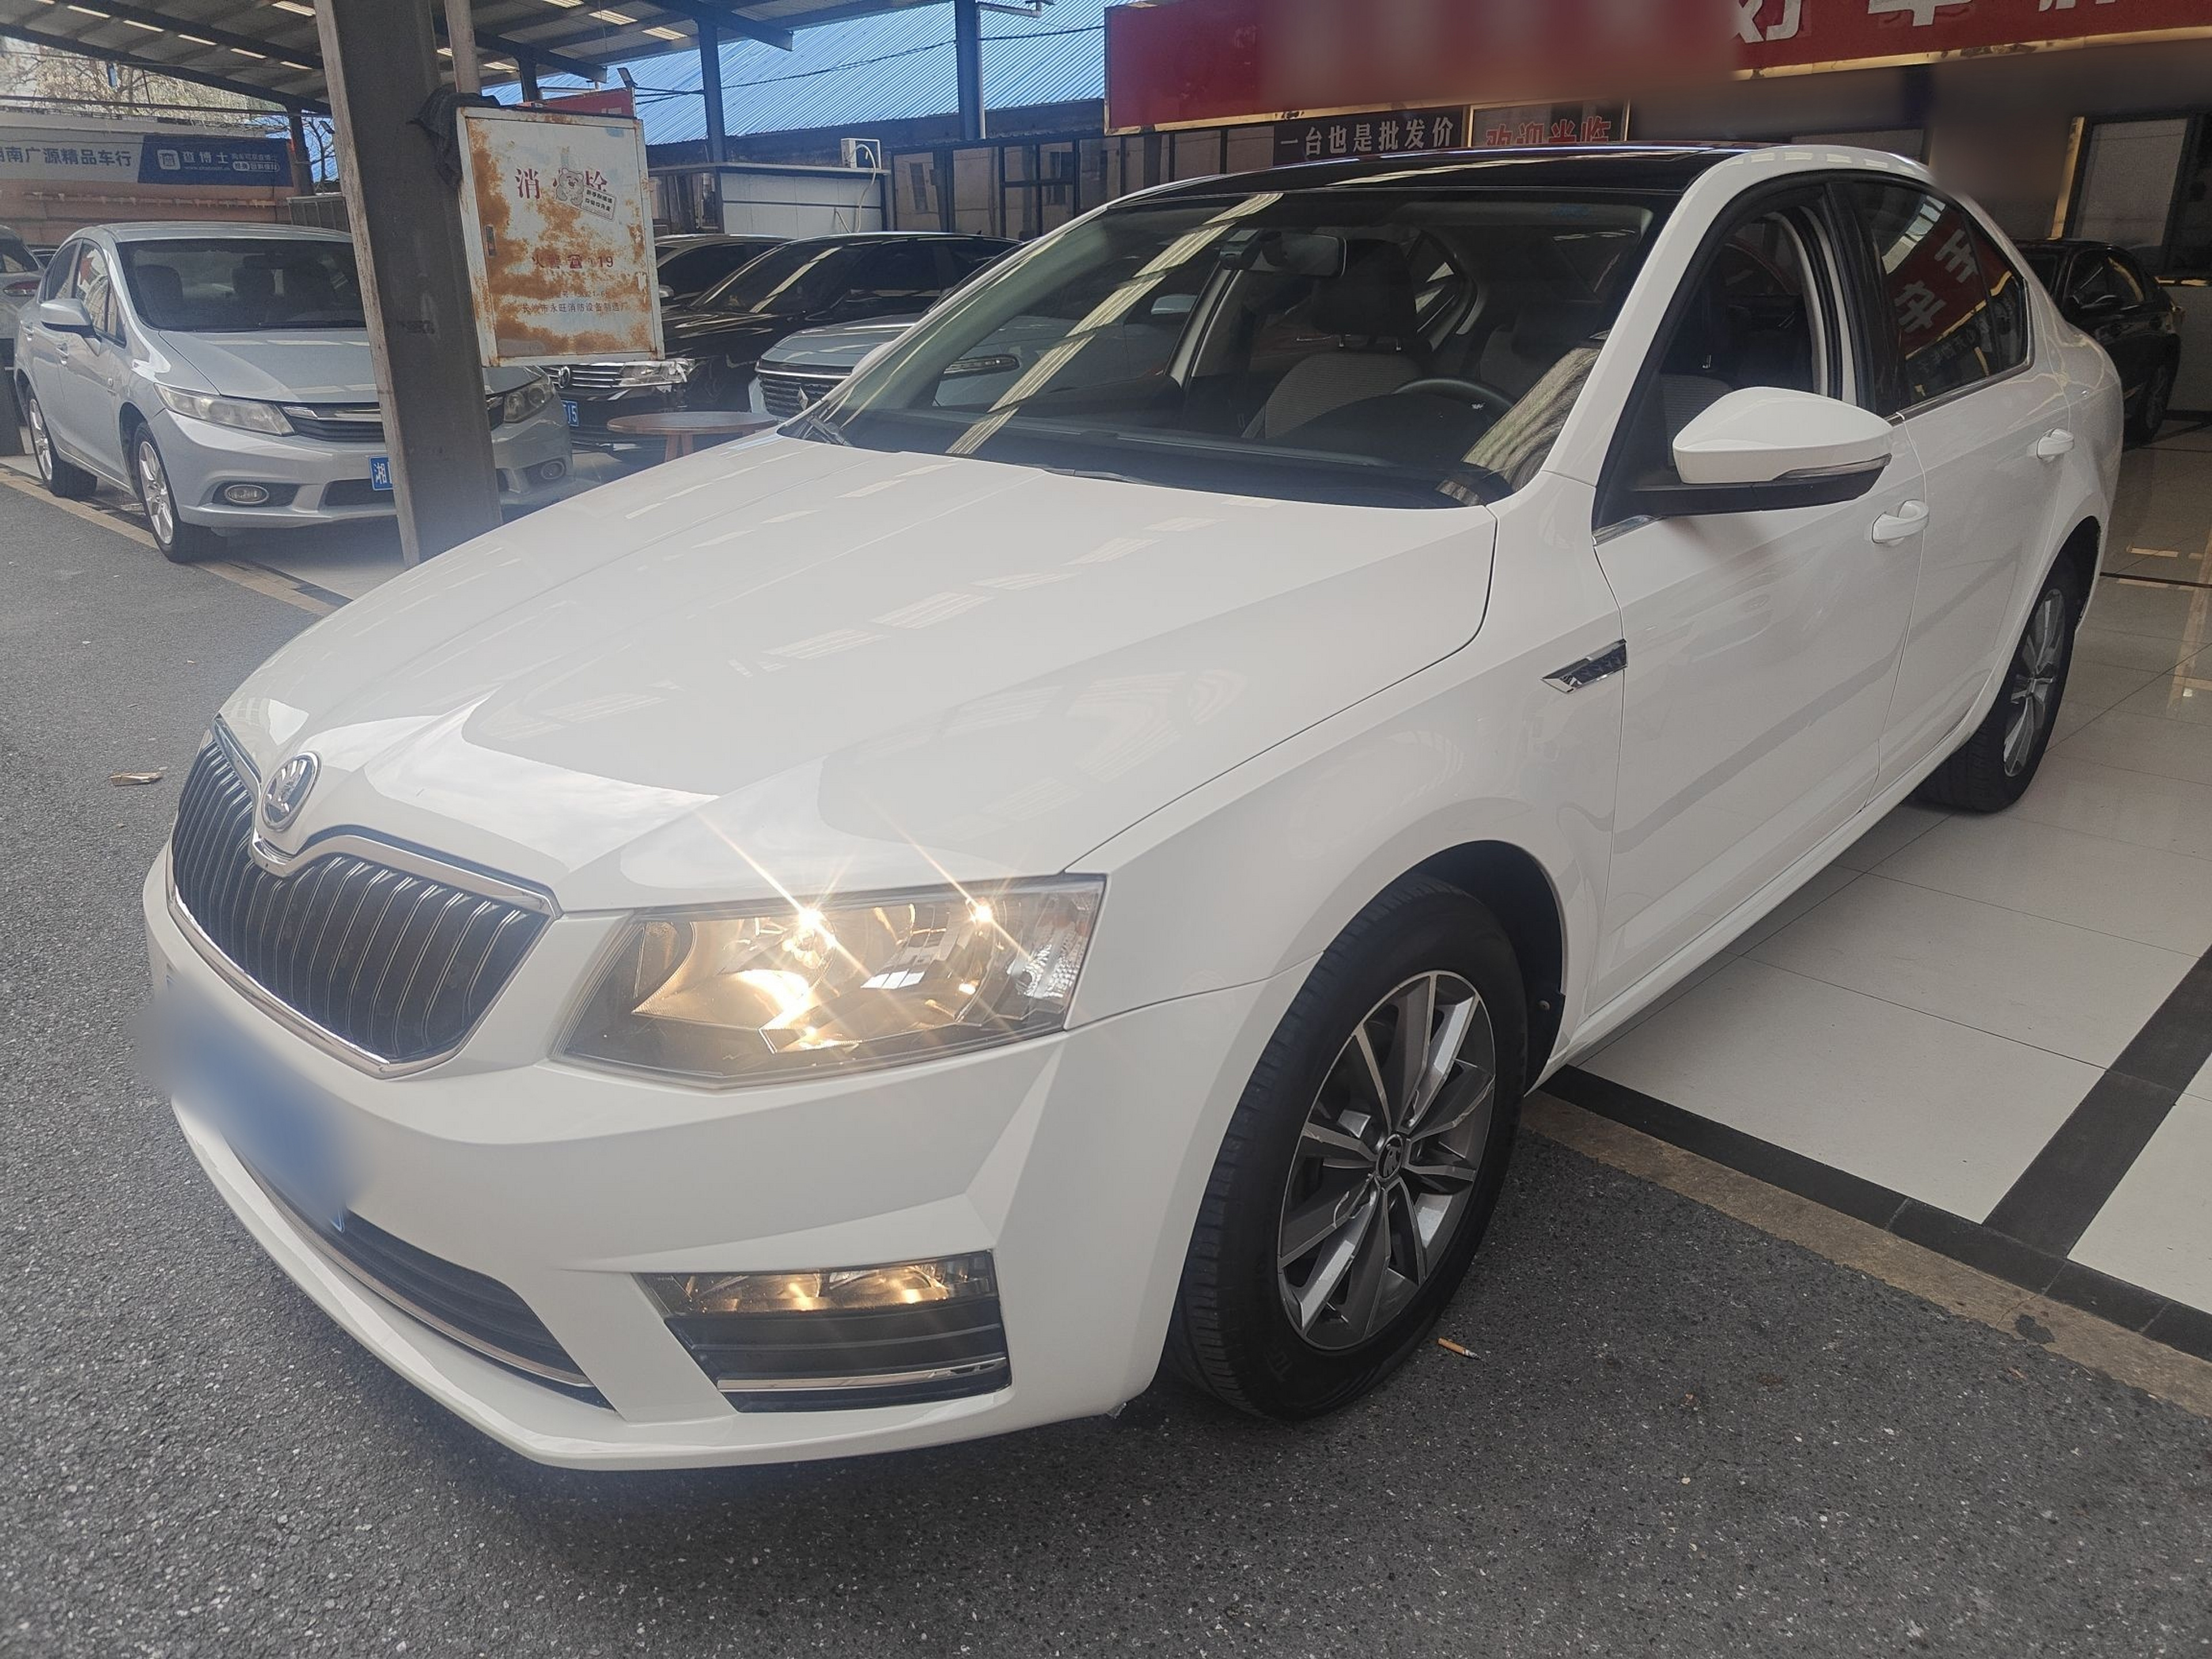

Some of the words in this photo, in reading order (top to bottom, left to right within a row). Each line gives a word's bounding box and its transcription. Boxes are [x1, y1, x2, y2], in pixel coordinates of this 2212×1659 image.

[1281, 117, 1453, 156] 一台也是批发价
[515, 168, 608, 199] 消栓
[373, 461, 392, 484] 湘
